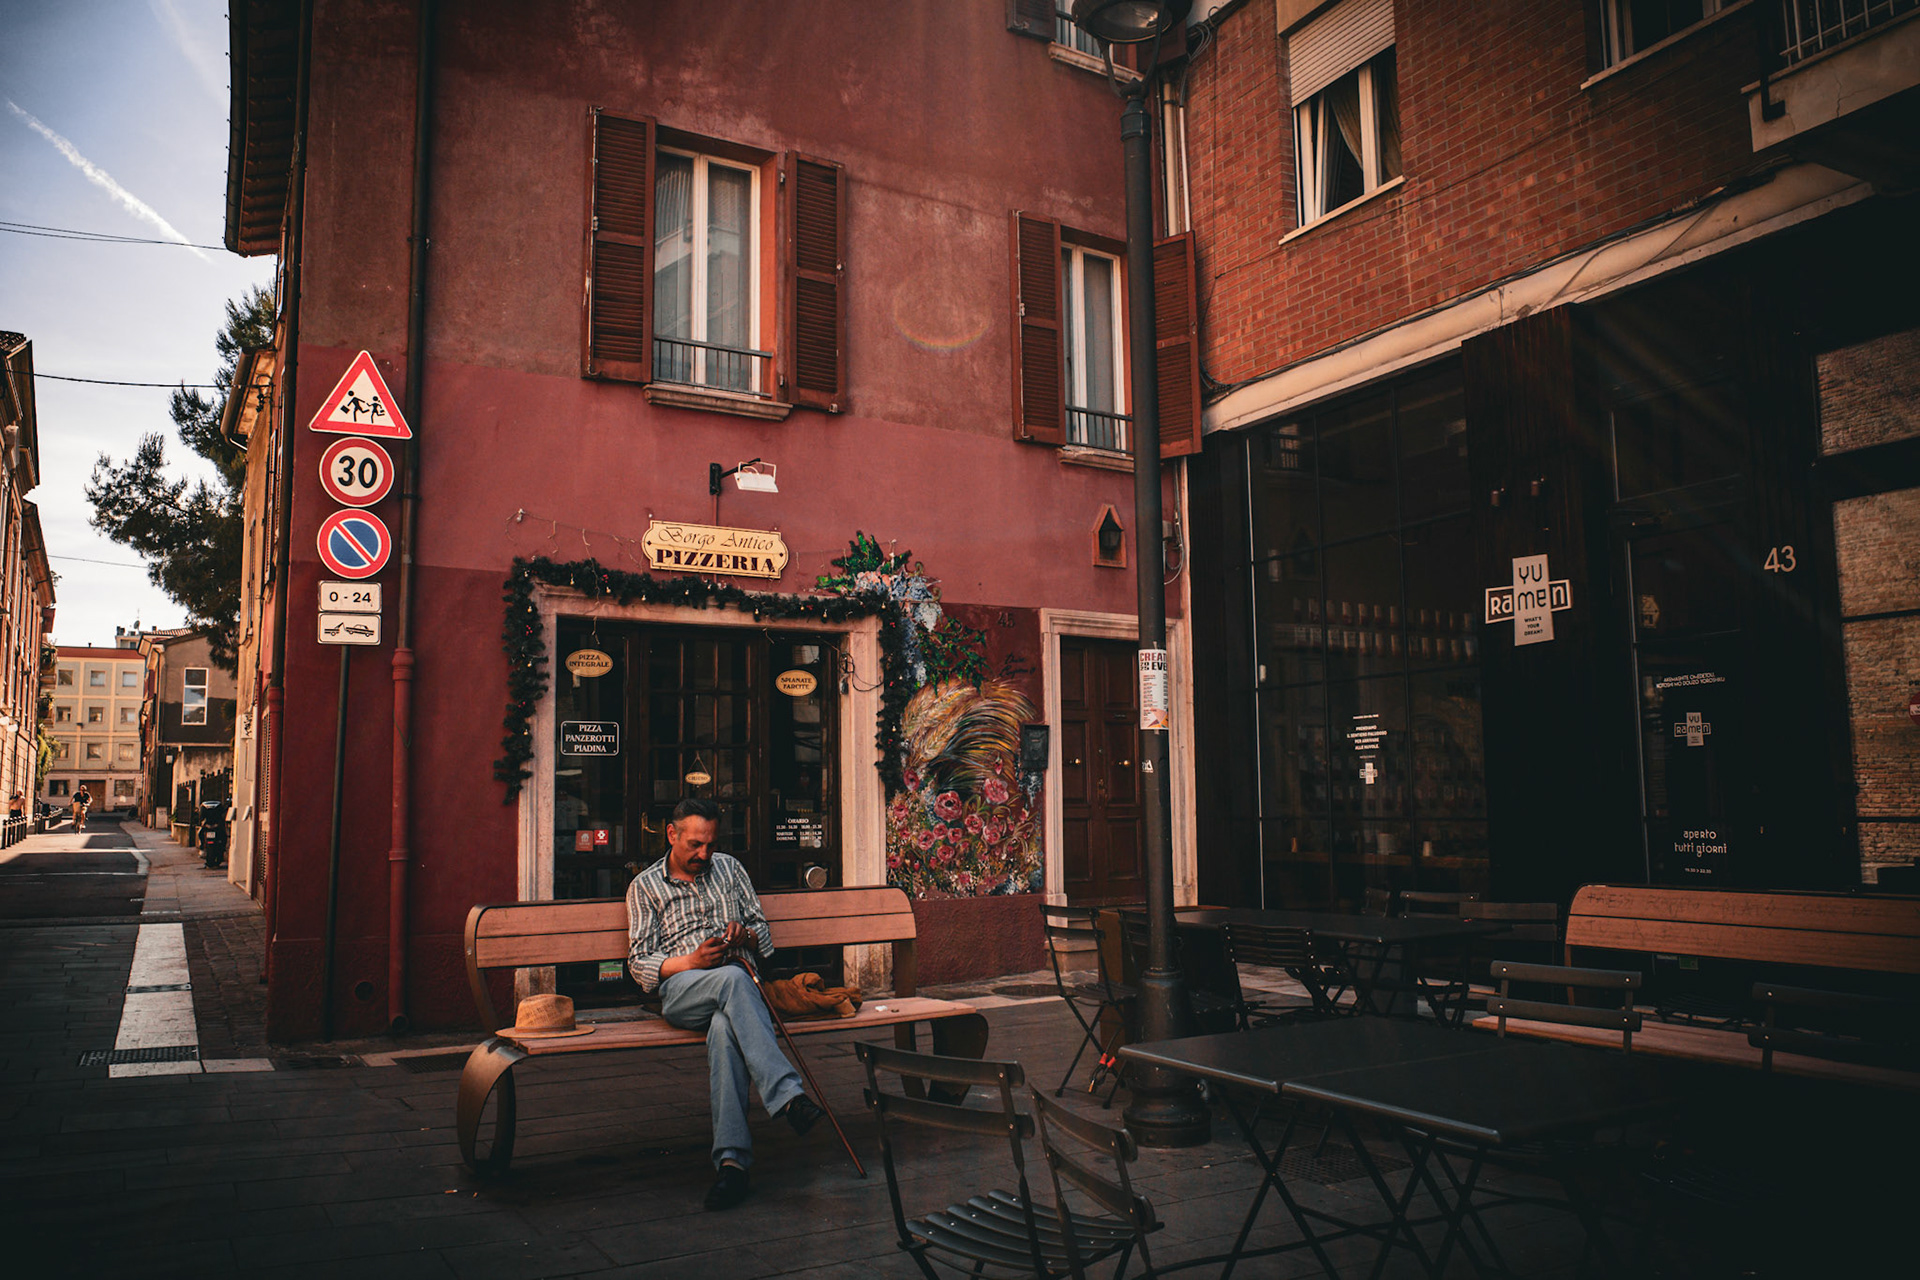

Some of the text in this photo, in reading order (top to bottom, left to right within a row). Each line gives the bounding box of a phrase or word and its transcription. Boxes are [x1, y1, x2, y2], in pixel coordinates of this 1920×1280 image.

[338, 455, 378, 488] 30
[658, 526, 774, 550] Borgo Antico
[656, 548, 776, 572] PIZZERIA
[1764, 546, 1796, 572] 43
[1519, 564, 1542, 584] YU
[330, 592, 338, 602] 0
[353, 592, 372, 604] 24
[1674, 842, 1727, 857] tutti giorni
